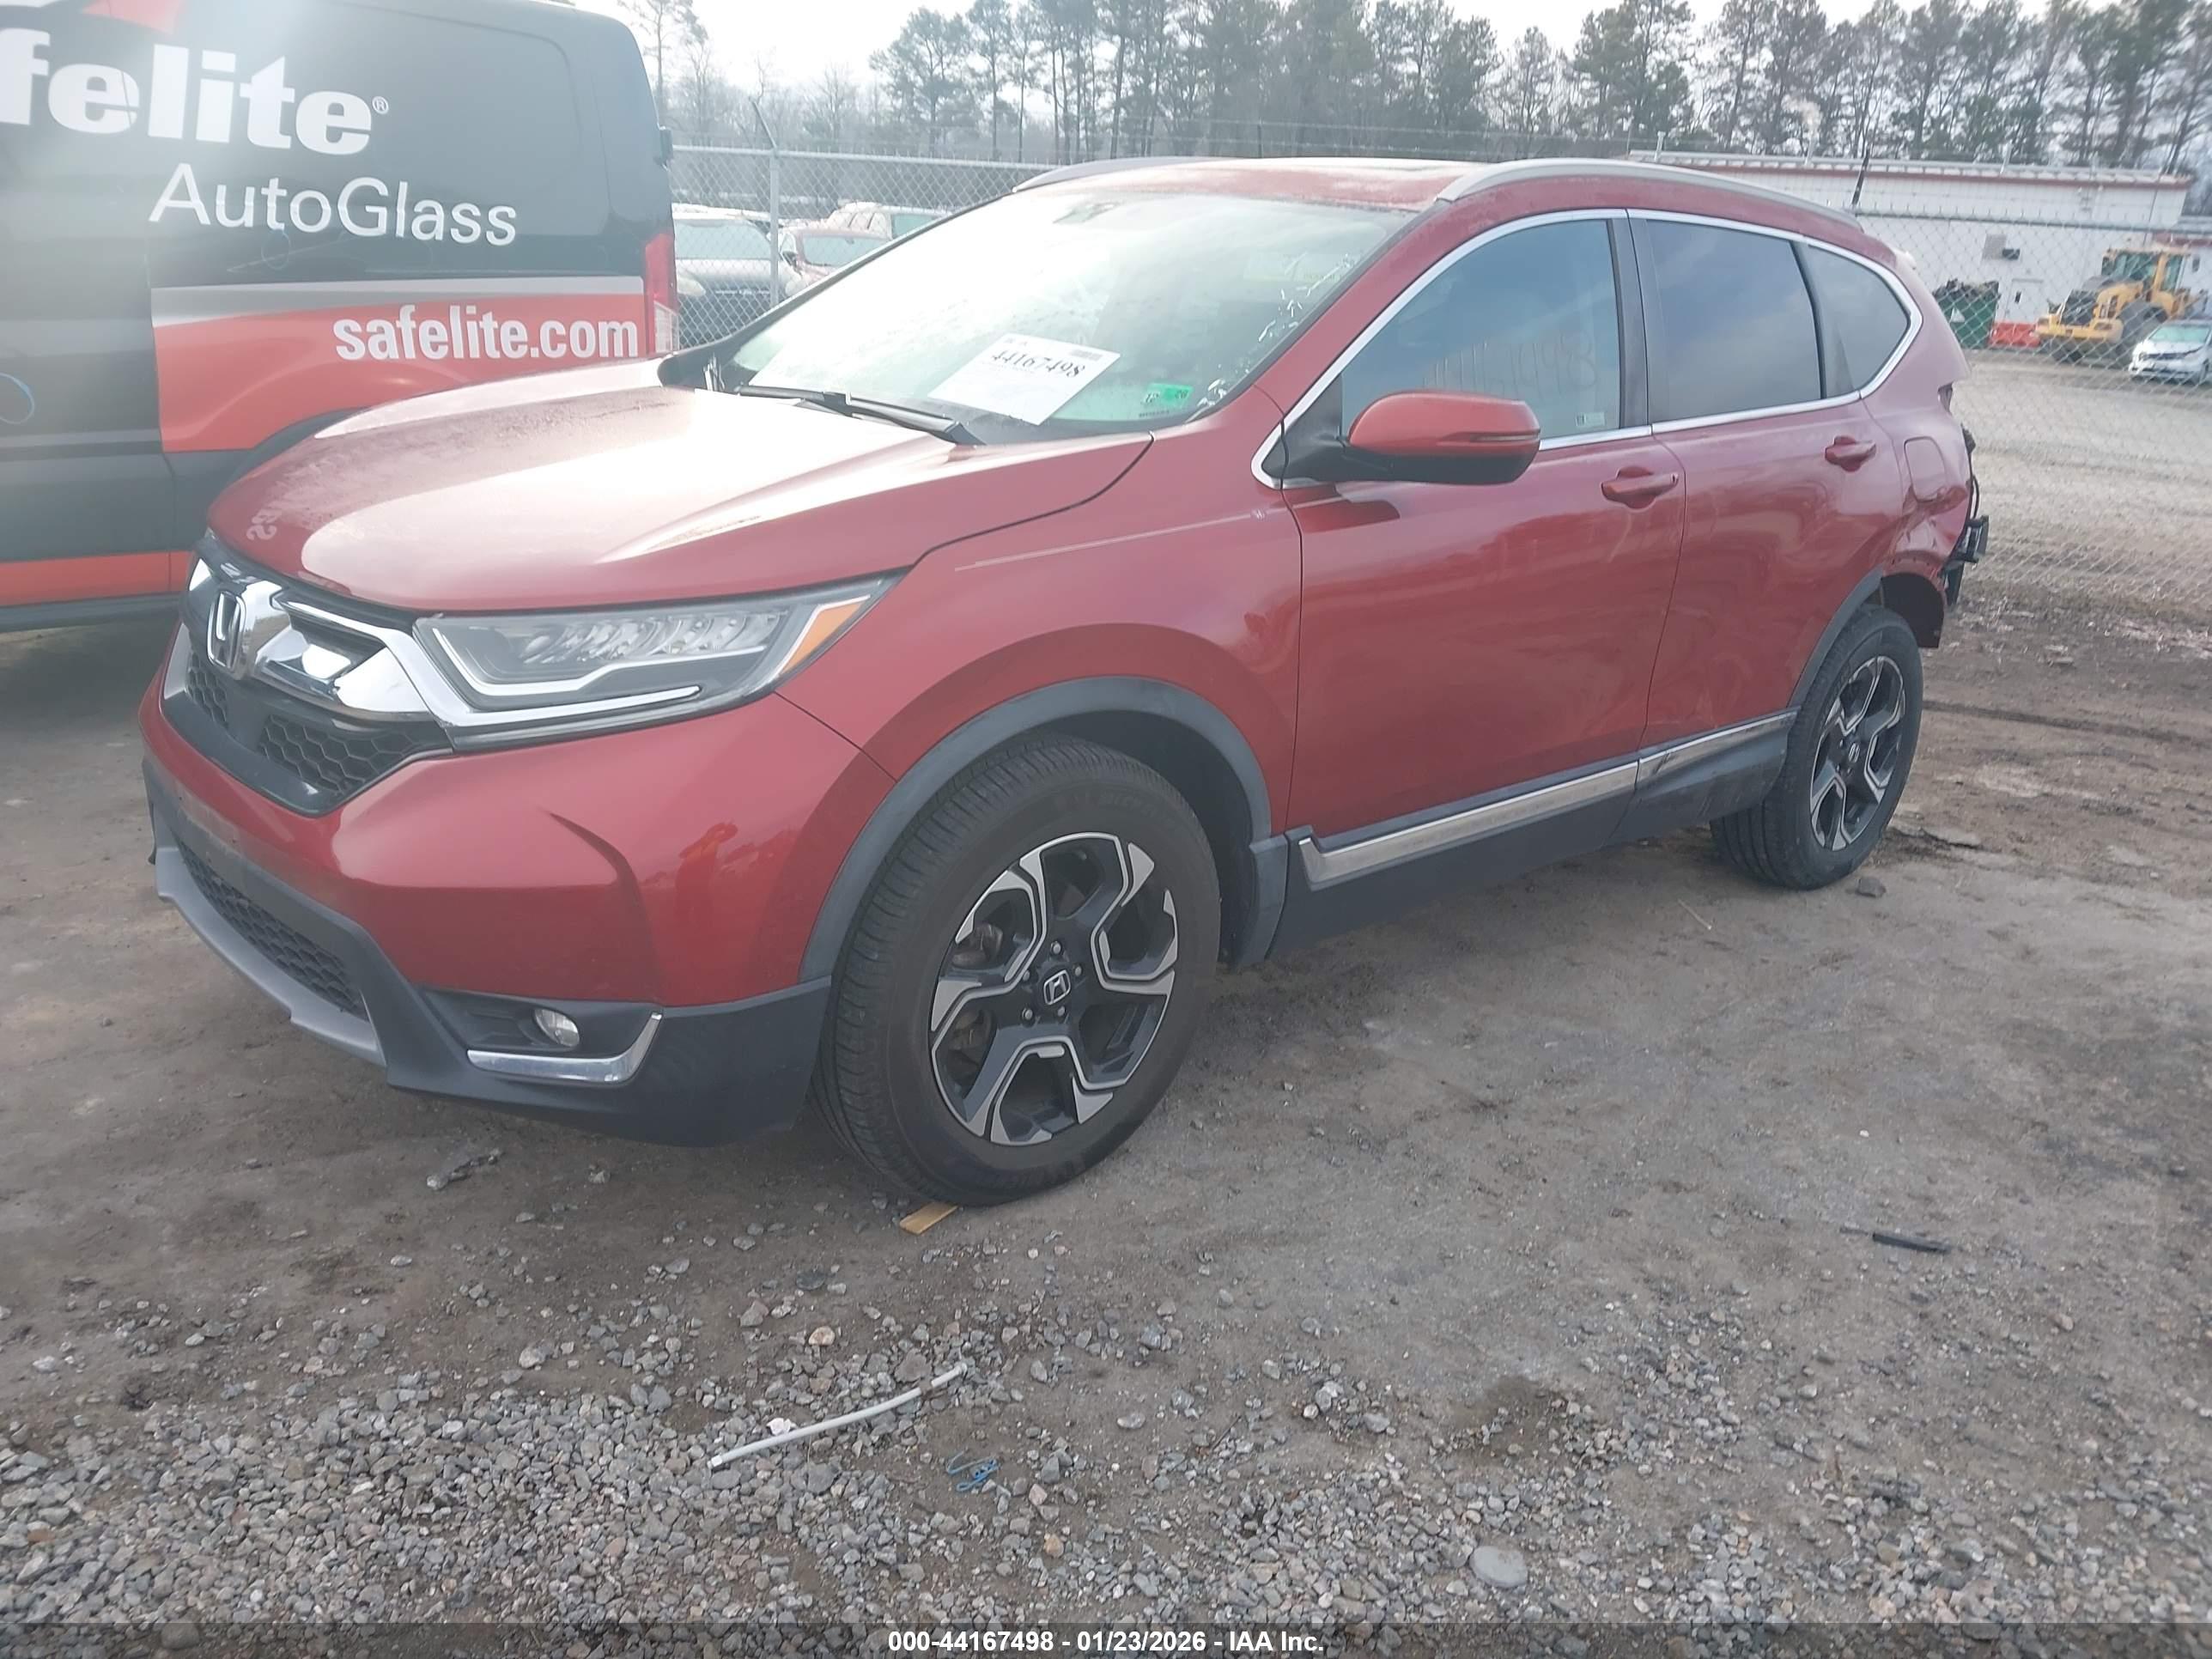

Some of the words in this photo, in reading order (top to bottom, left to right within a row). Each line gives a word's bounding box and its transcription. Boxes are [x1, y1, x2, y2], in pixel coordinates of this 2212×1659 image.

[149, 162, 517, 246] AutoGlass
[332, 304, 639, 361] safelite.com
[991, 349, 1086, 378] 44167498
